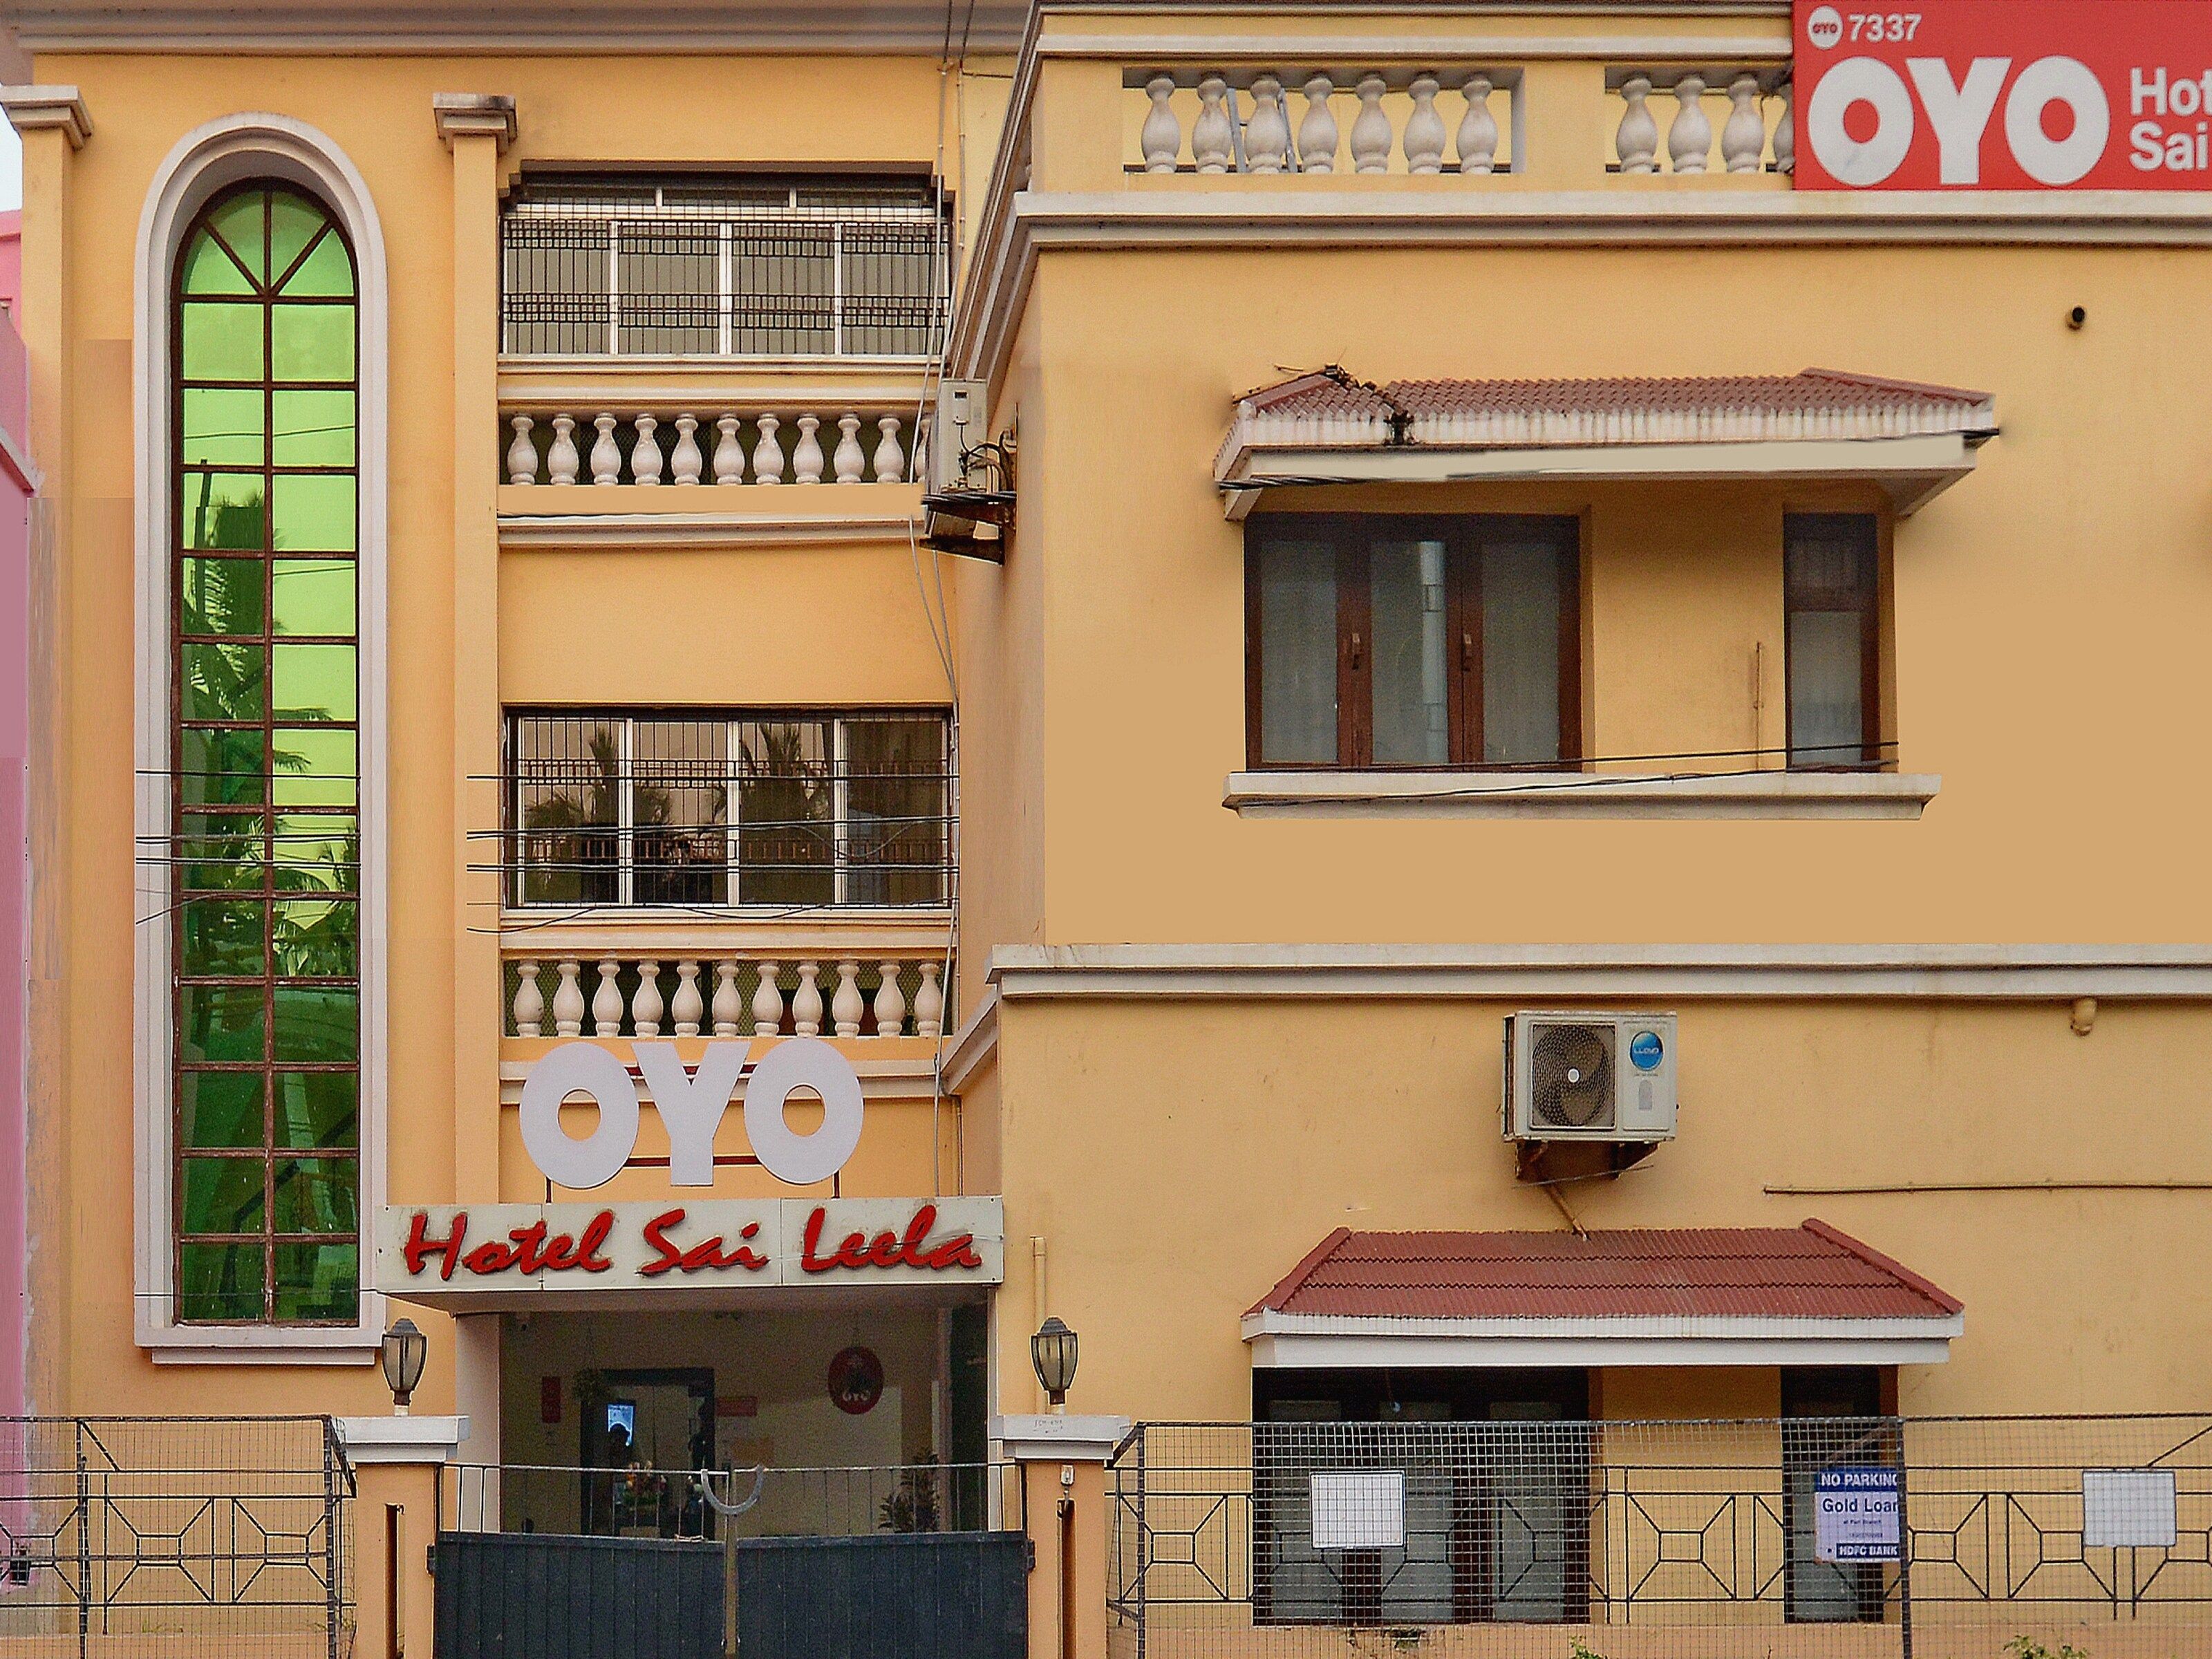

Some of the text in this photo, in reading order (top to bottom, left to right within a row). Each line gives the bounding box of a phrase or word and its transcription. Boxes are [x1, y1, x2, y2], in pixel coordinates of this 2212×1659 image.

[1848, 13, 1922, 41] 7337
[1808, 55, 2110, 187] OYO
[2129, 120, 2209, 171] Sai
[519, 1039, 864, 1189] OYO
[404, 1205, 982, 1281] Hotel Sai Leela
[1821, 1473, 1840, 1486] NO
[1822, 1498, 1857, 1512] Gold
[1839, 1546, 1897, 1556] HDFC BANK
